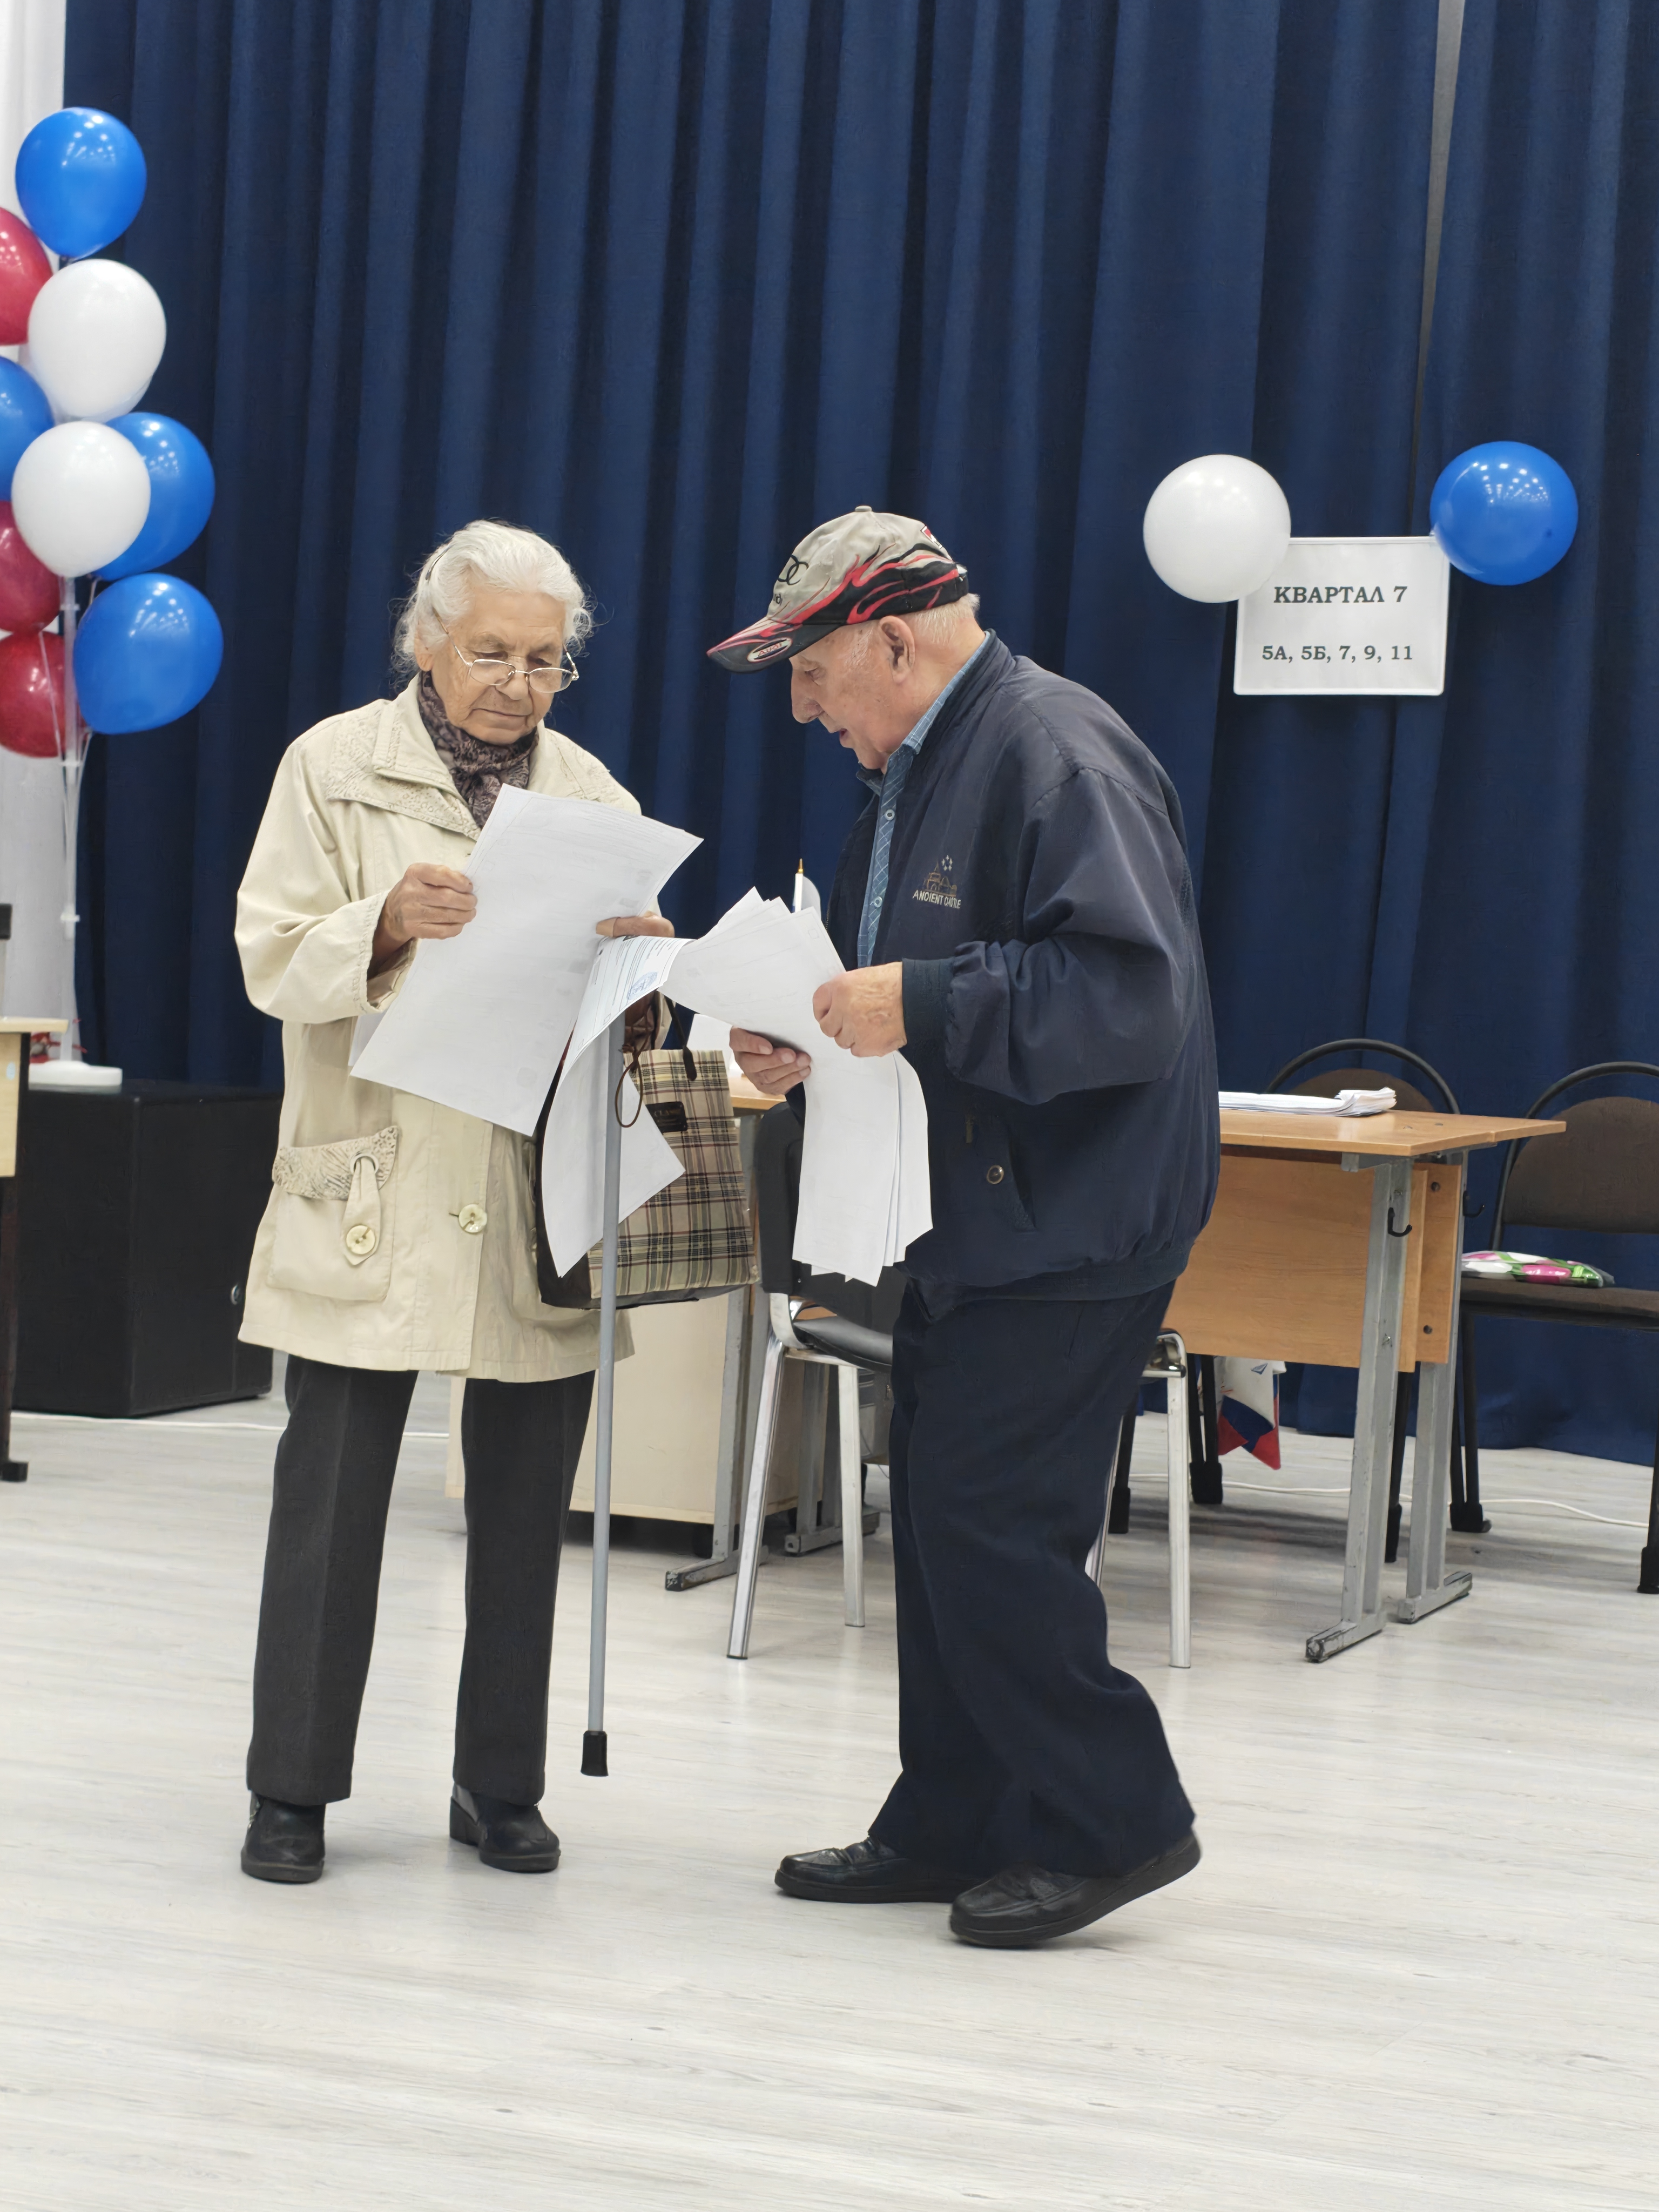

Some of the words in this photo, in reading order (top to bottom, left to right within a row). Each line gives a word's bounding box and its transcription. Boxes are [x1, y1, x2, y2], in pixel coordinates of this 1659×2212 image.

[1273, 586, 1385, 603] КВАРТАЛ
[1393, 585, 1407, 603] 7
[1262, 645, 1293, 663] 5А,
[1301, 645, 1331, 663] 5Б,
[1339, 645, 1356, 663] 7,
[1364, 645, 1381, 663] 9,
[1391, 645, 1413, 660] 11
